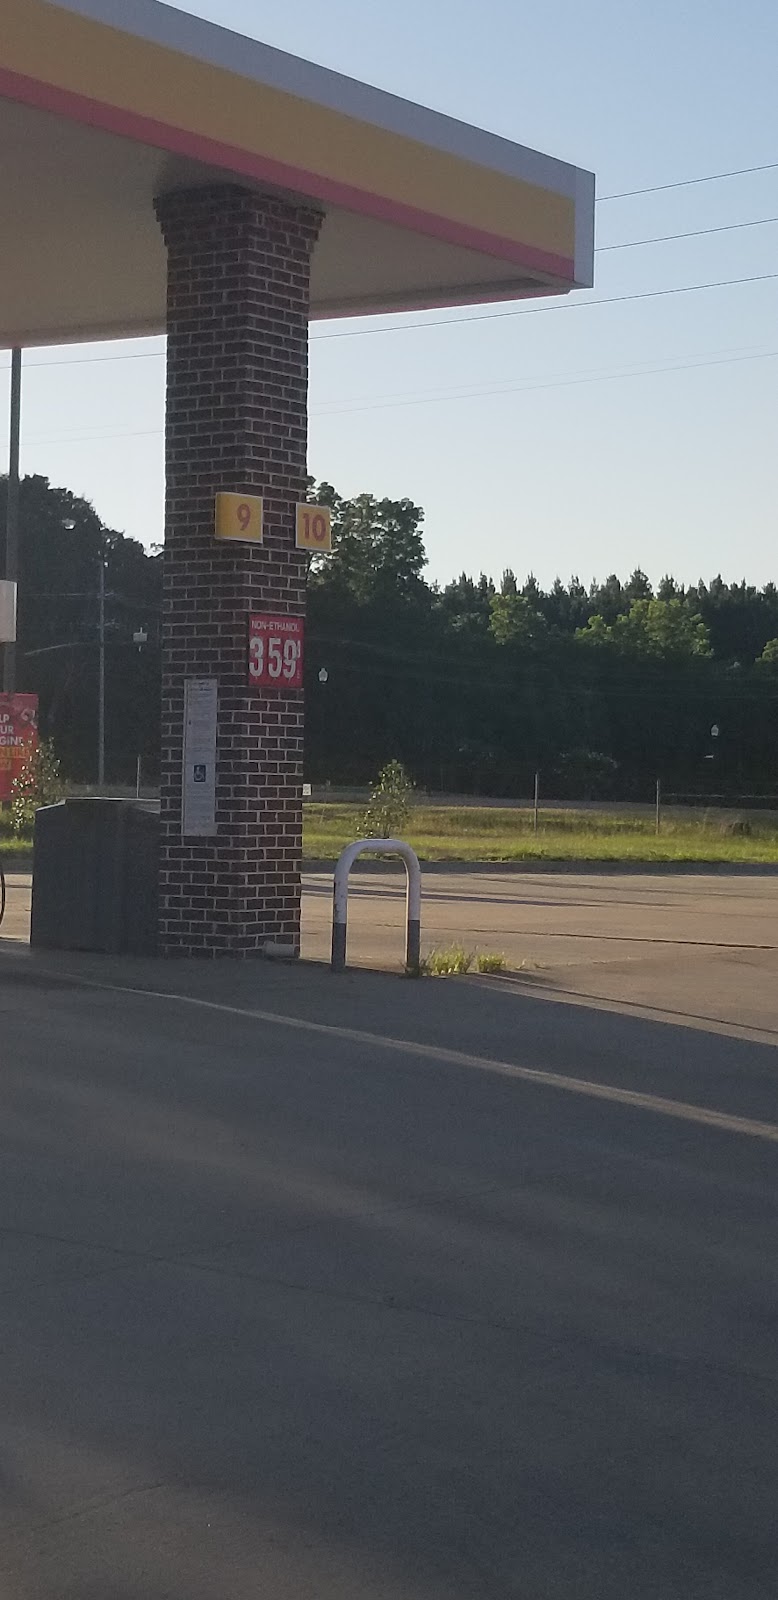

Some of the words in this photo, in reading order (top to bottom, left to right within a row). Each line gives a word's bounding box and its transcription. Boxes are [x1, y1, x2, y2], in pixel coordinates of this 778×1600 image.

[236, 503, 251, 531] 9
[302, 512, 326, 542] 10
[251, 619, 300, 633] NON-ETHANOL
